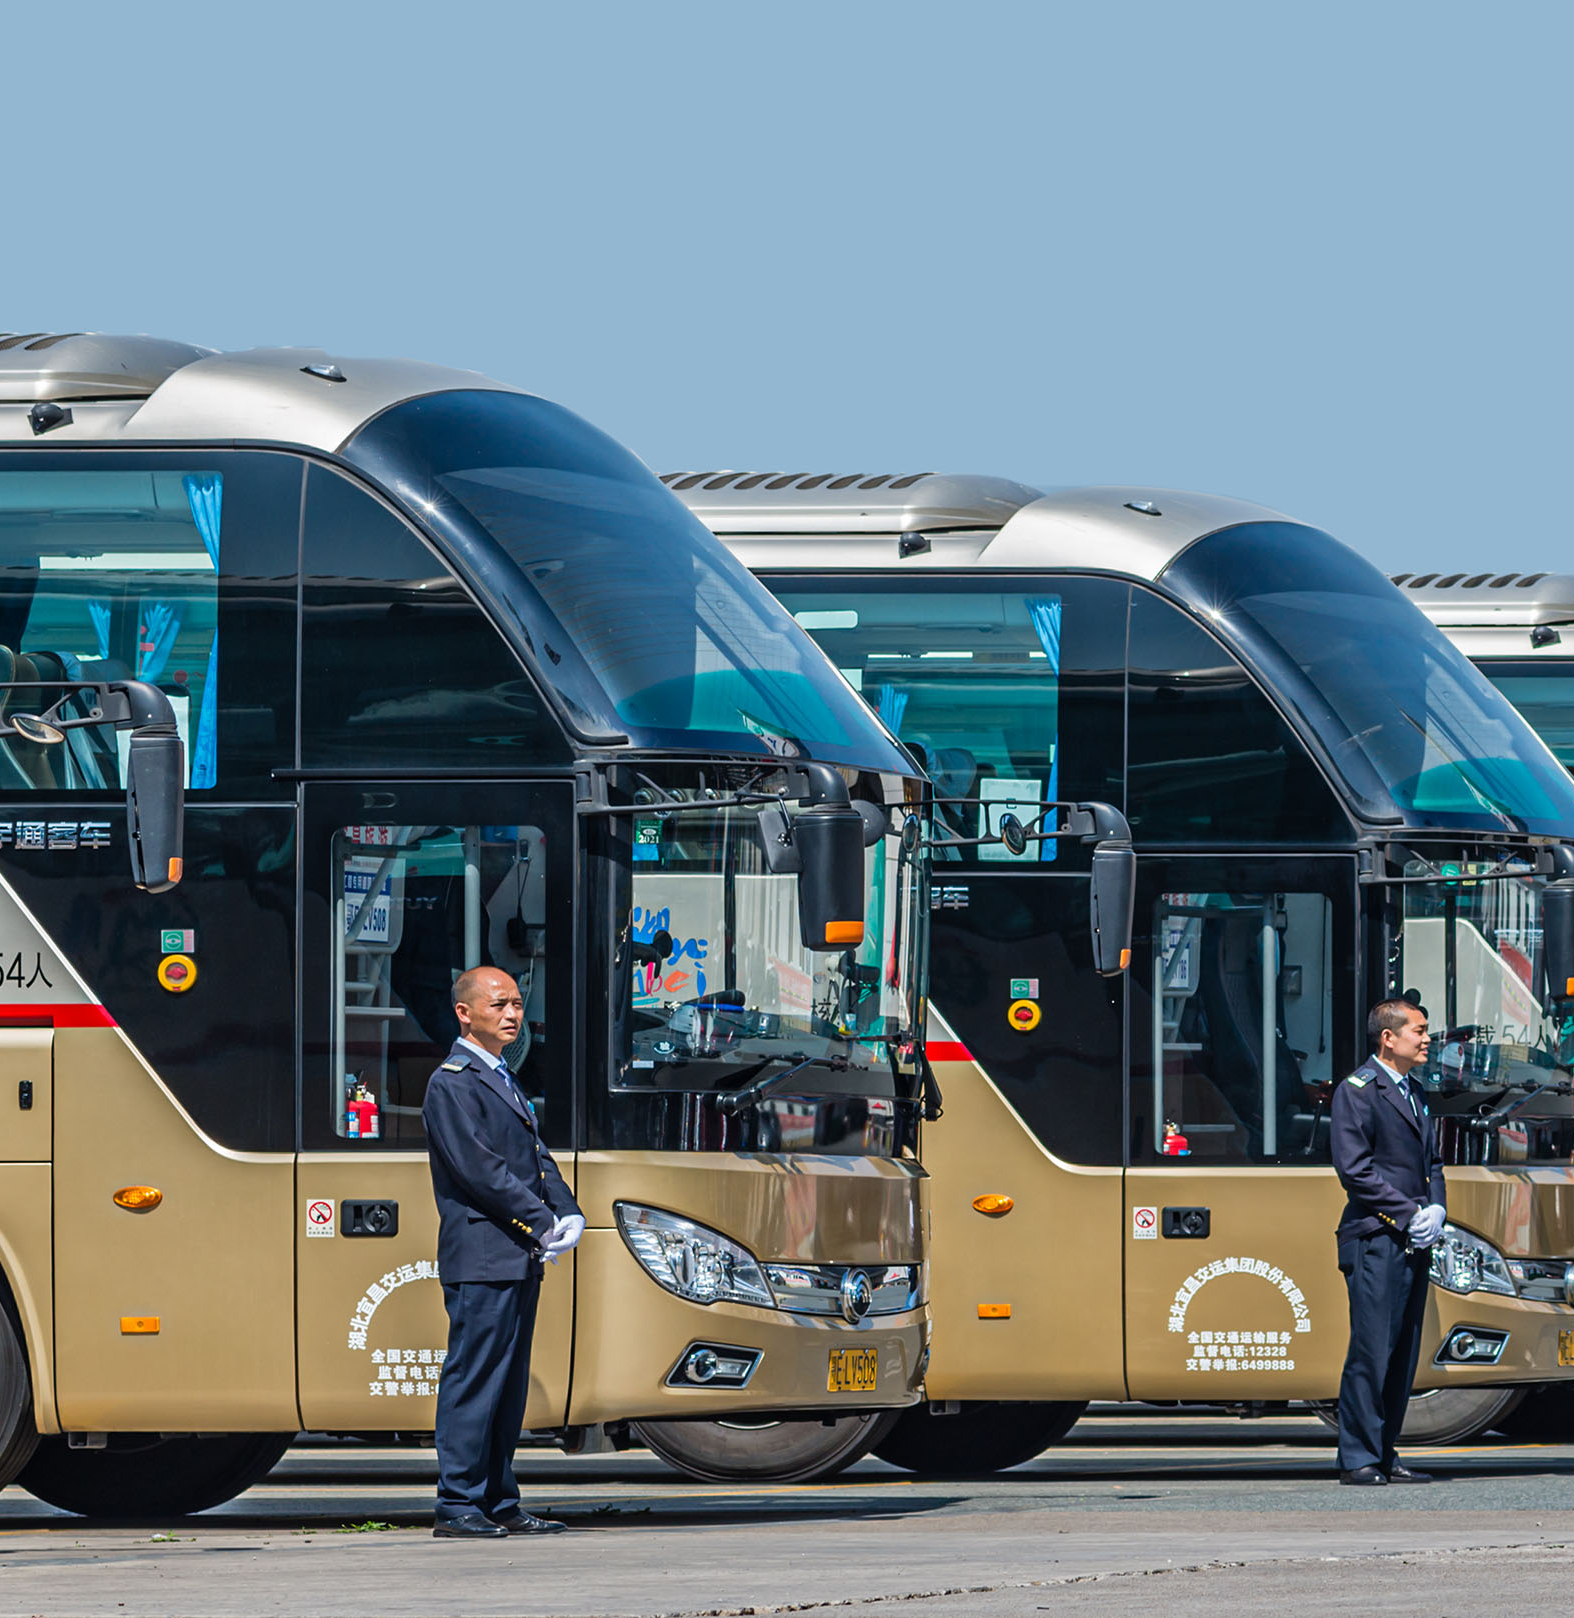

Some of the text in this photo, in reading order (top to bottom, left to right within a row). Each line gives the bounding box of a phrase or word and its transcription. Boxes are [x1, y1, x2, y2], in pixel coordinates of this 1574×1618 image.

[638, 834, 660, 844] 2021
[1168, 1257, 1311, 1333] 湖北宜昌交运集团股份有限公司
[1187, 1331, 1292, 1344] 全国交通运输服务
[1193, 1345, 1287, 1358] 监督电话:12328
[1185, 1358, 1295, 1371] 交警举报:6499888
